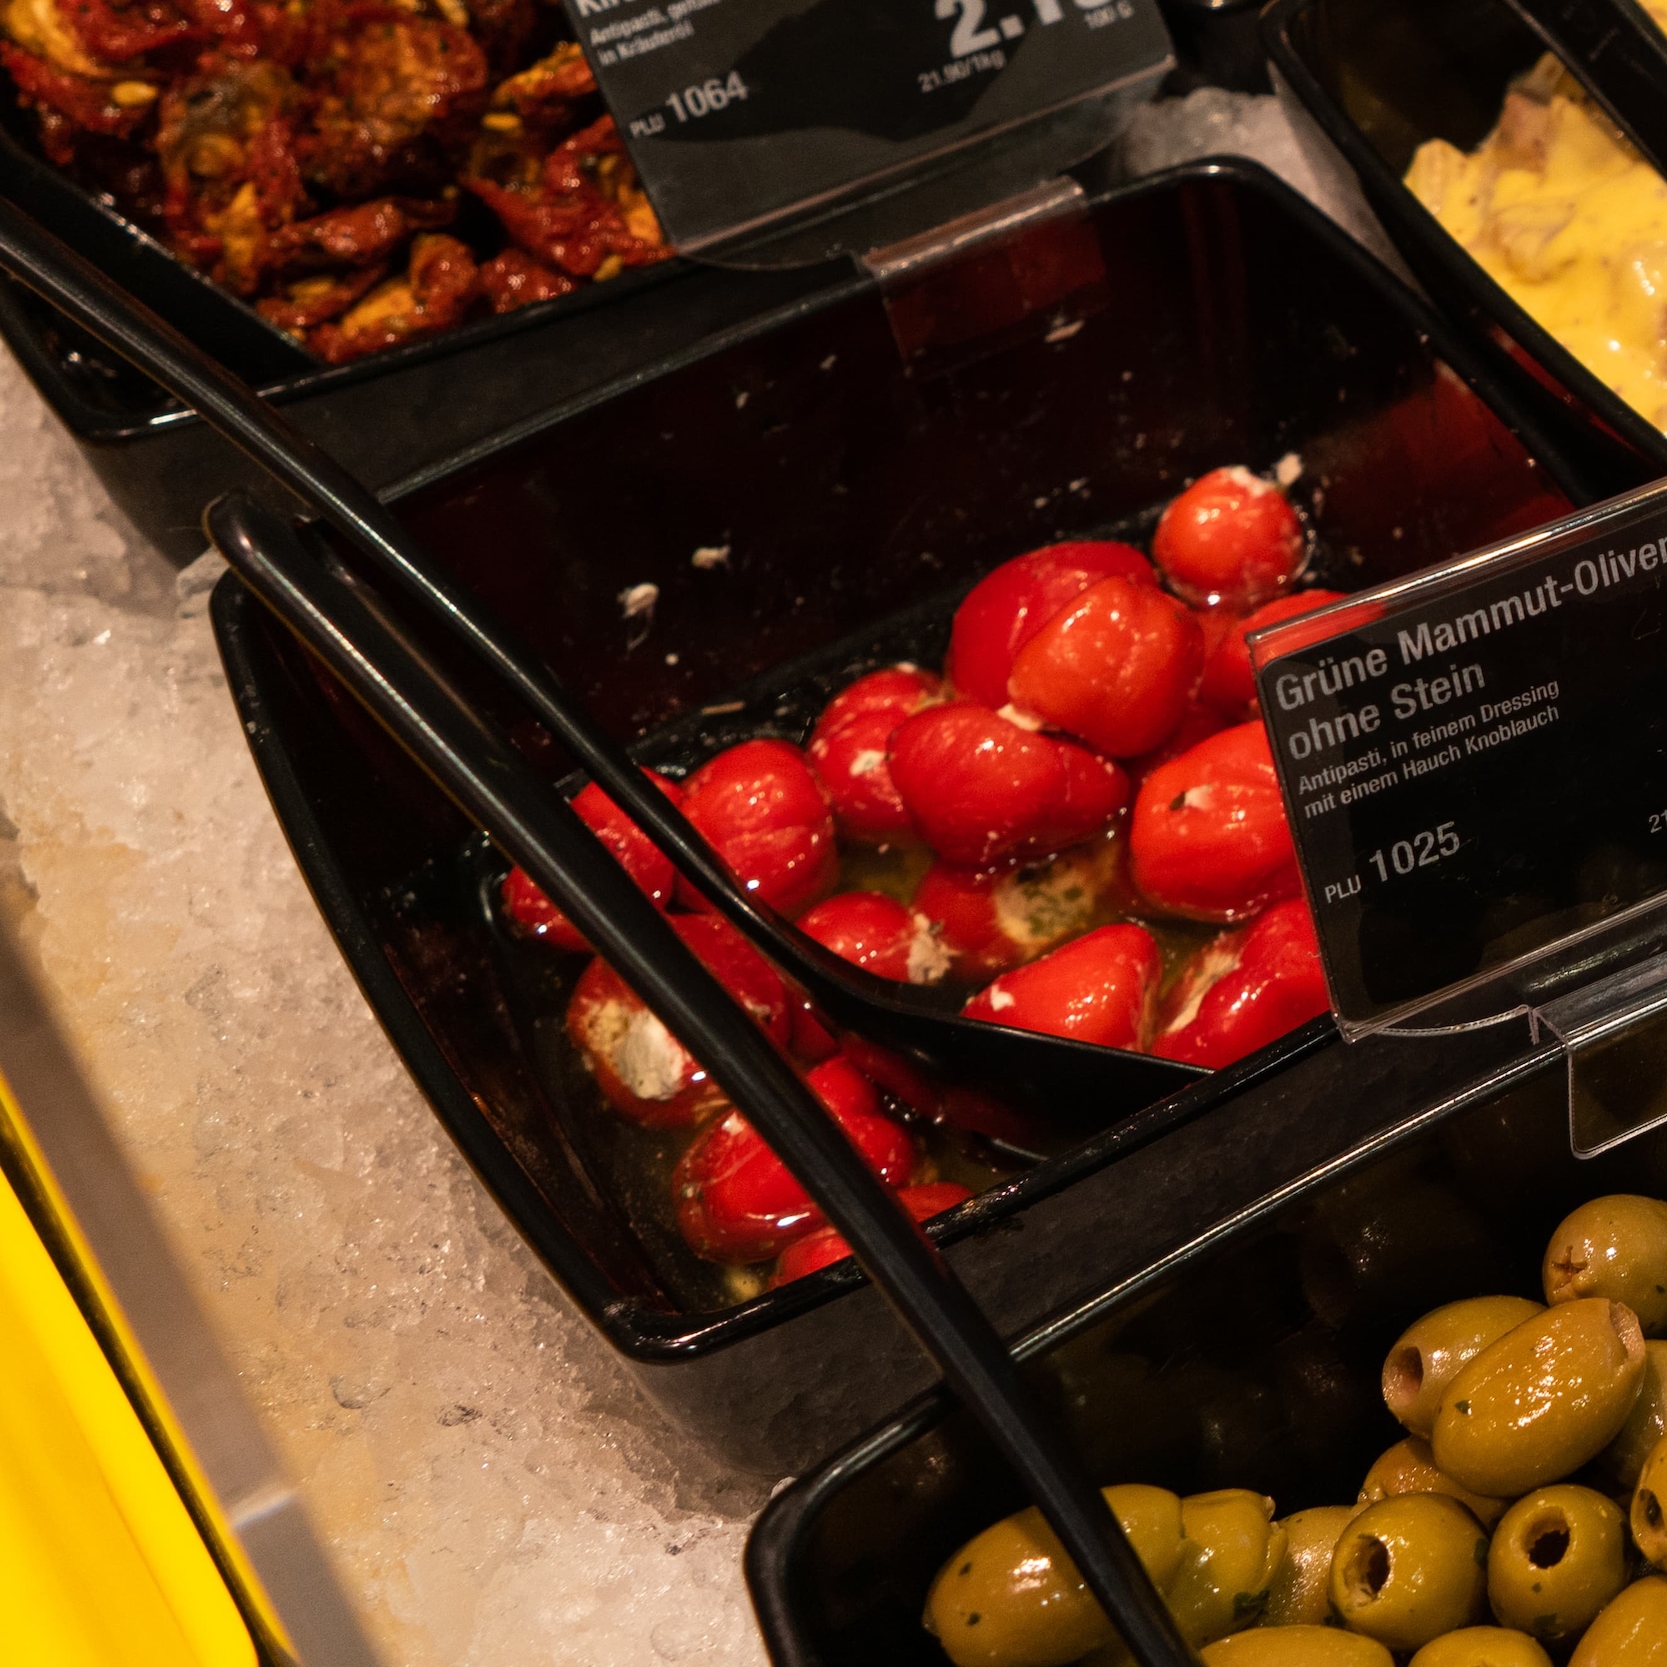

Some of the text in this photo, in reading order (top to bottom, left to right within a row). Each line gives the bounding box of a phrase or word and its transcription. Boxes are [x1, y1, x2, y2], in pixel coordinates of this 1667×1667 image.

[589, 8, 666, 45] Antipasti,
[597, 21, 693, 66] in Kräuteröl
[917, 49, 1005, 92] 21.90/1kg
[628, 71, 747, 137] PLU 1064
[1275, 647, 1387, 710] Grüne
[1288, 663, 1485, 759] ohne Stein
[1298, 680, 1560, 795] Antipasti, in feinem Dressing
[1303, 705, 1559, 819] mit einem Hauch Knoblauch
[1323, 820, 1460, 903] PLU 1025
